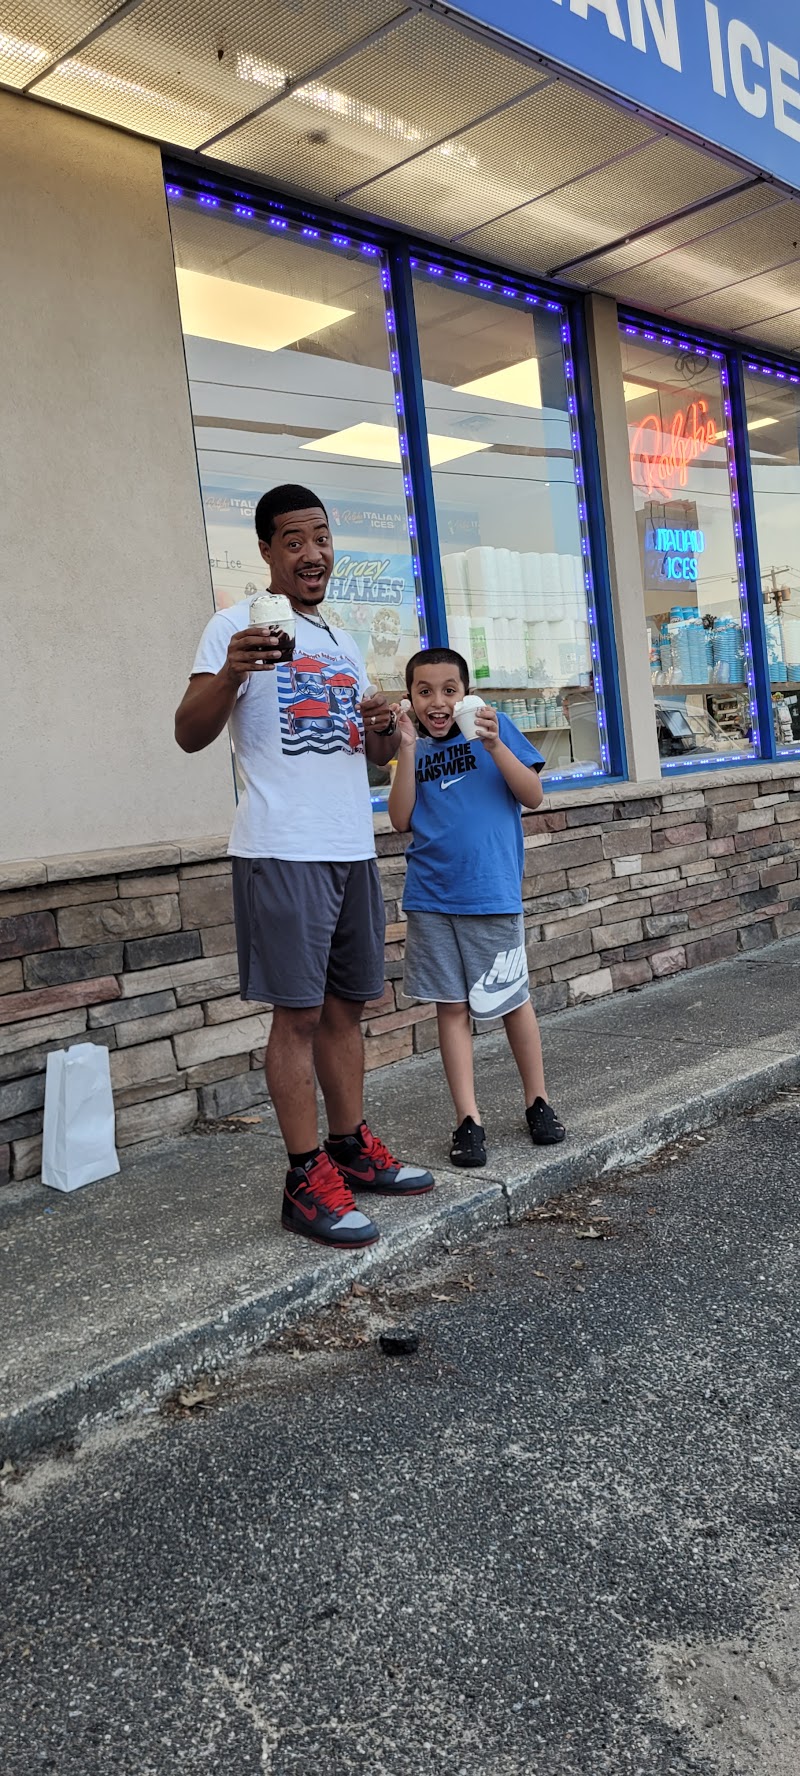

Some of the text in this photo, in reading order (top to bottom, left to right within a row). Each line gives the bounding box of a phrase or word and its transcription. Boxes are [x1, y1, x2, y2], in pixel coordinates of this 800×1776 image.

[363, 511, 401, 522] ITALIAN
[371, 520, 395, 529] ICES
[209, 557, 221, 568] er
[333, 554, 391, 581] Crazy
[666, 556, 698, 580] ICES
[326, 576, 404, 605] HAKES
[418, 743, 472, 769] I AM THE
[415, 755, 478, 783] ANSWER
